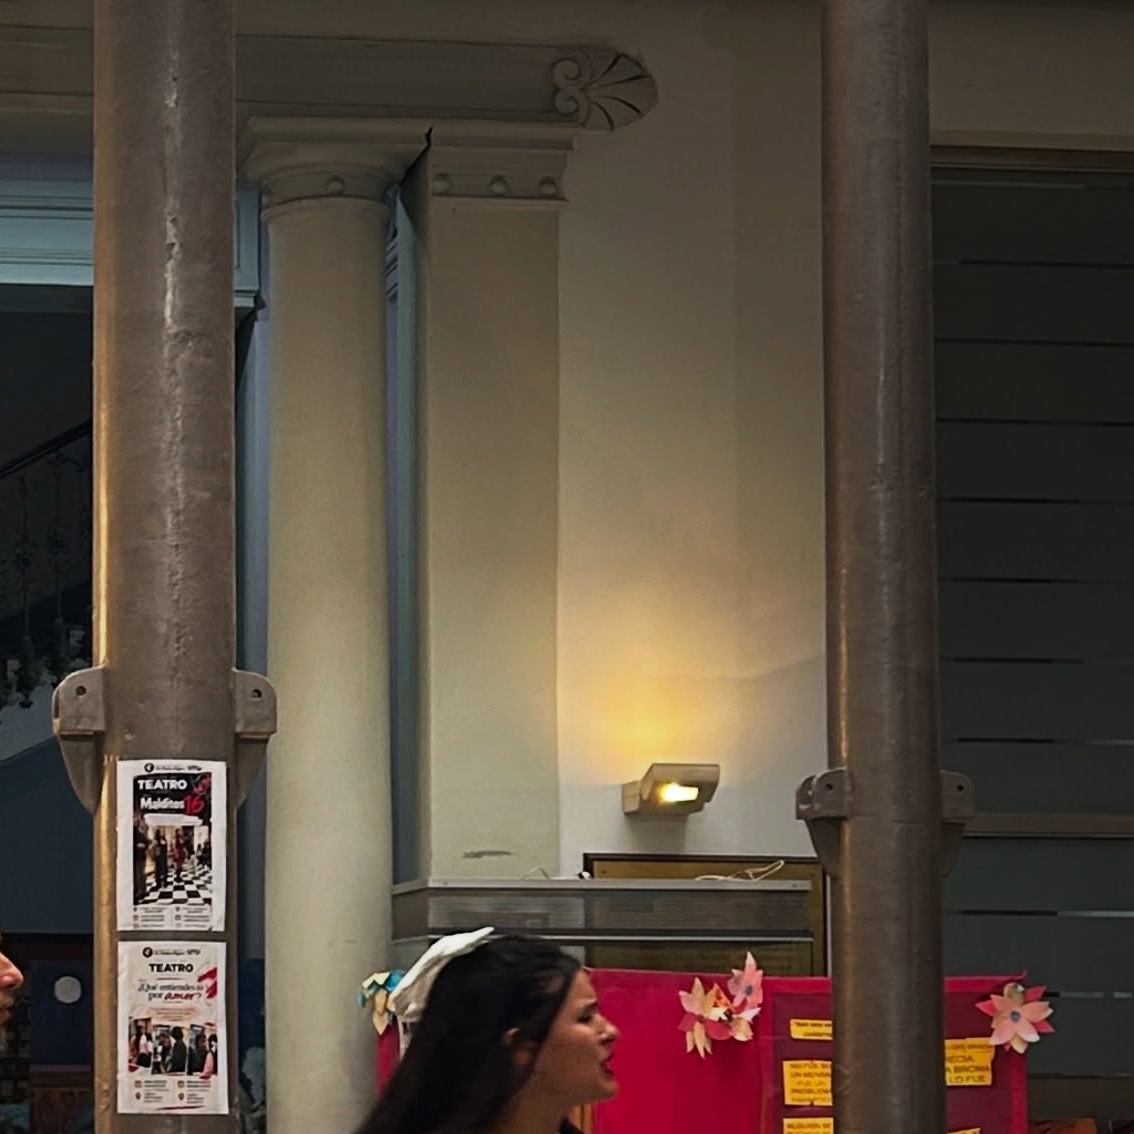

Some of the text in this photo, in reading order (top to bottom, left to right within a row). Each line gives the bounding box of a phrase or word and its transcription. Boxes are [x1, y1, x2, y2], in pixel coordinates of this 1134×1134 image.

[137, 779, 188, 790] TEATRO
[148, 963, 194, 972] TEATRO
[148, 992, 163, 1001] por
